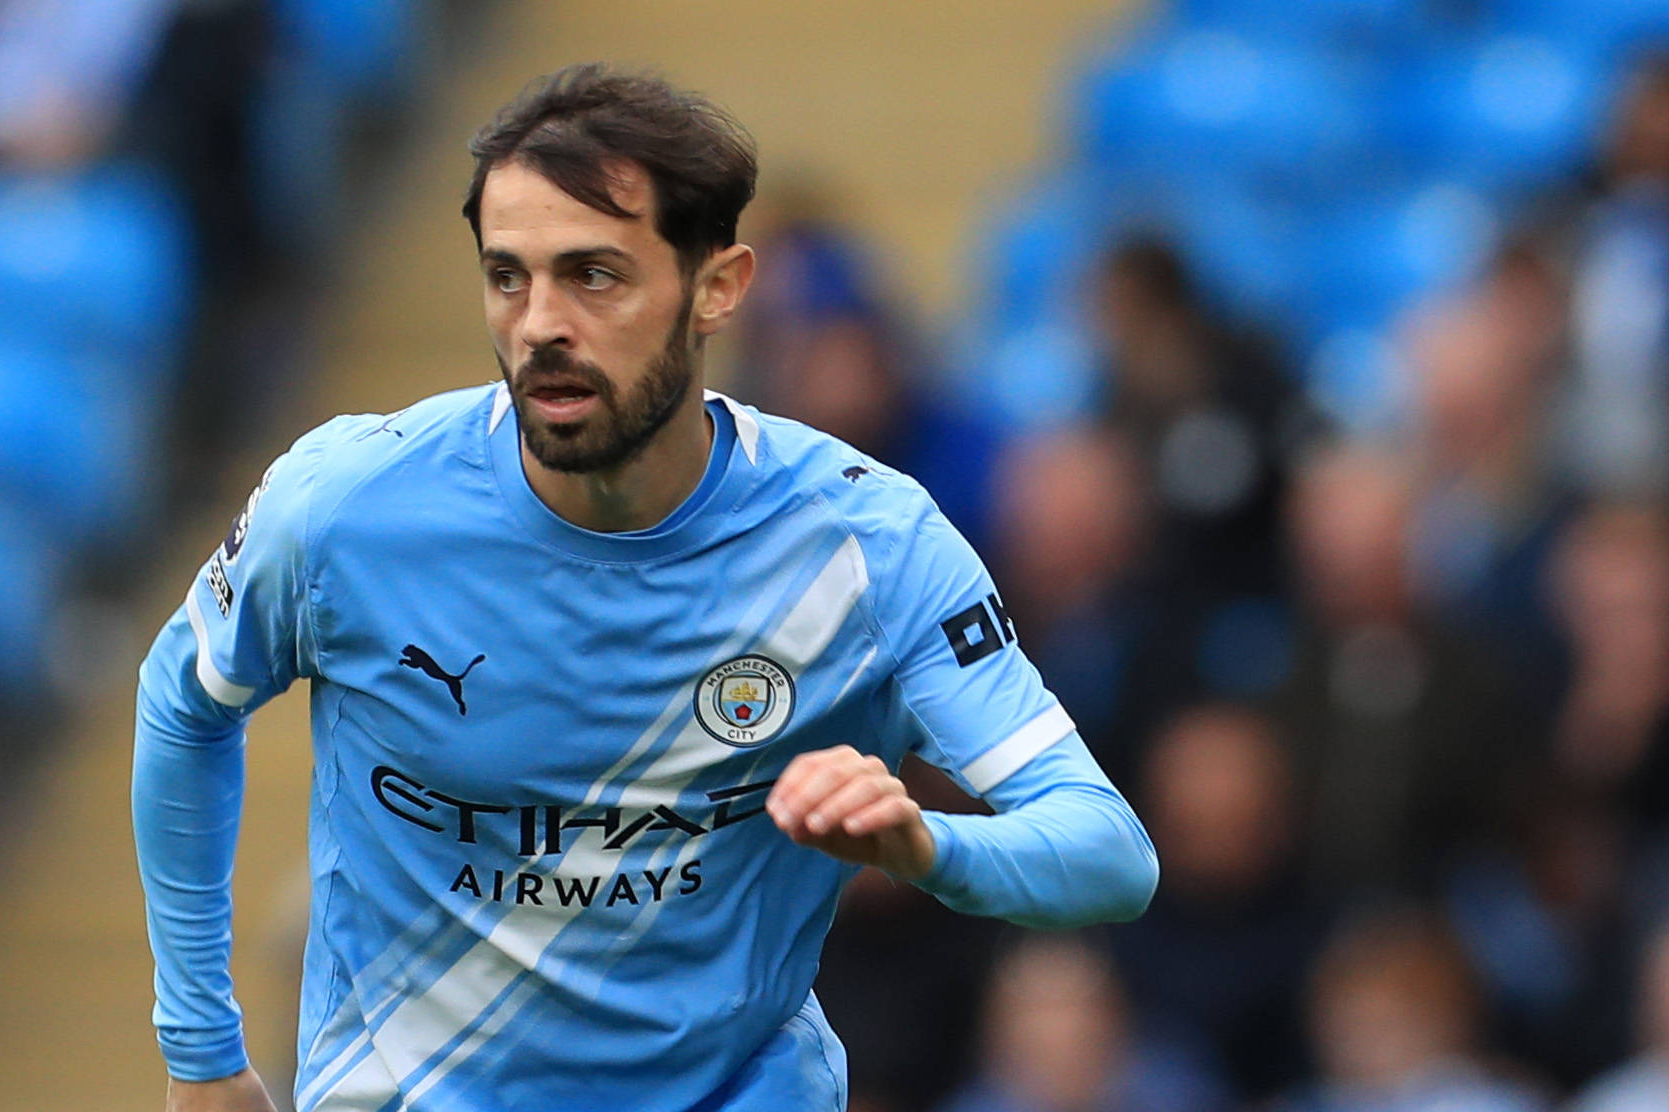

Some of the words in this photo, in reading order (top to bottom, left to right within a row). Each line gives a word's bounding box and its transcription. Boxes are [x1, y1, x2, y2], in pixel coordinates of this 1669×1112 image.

[707, 661, 786, 688] MANCHESTER
[727, 729, 757, 741] CITY
[449, 859, 703, 908] AIRWAYS
